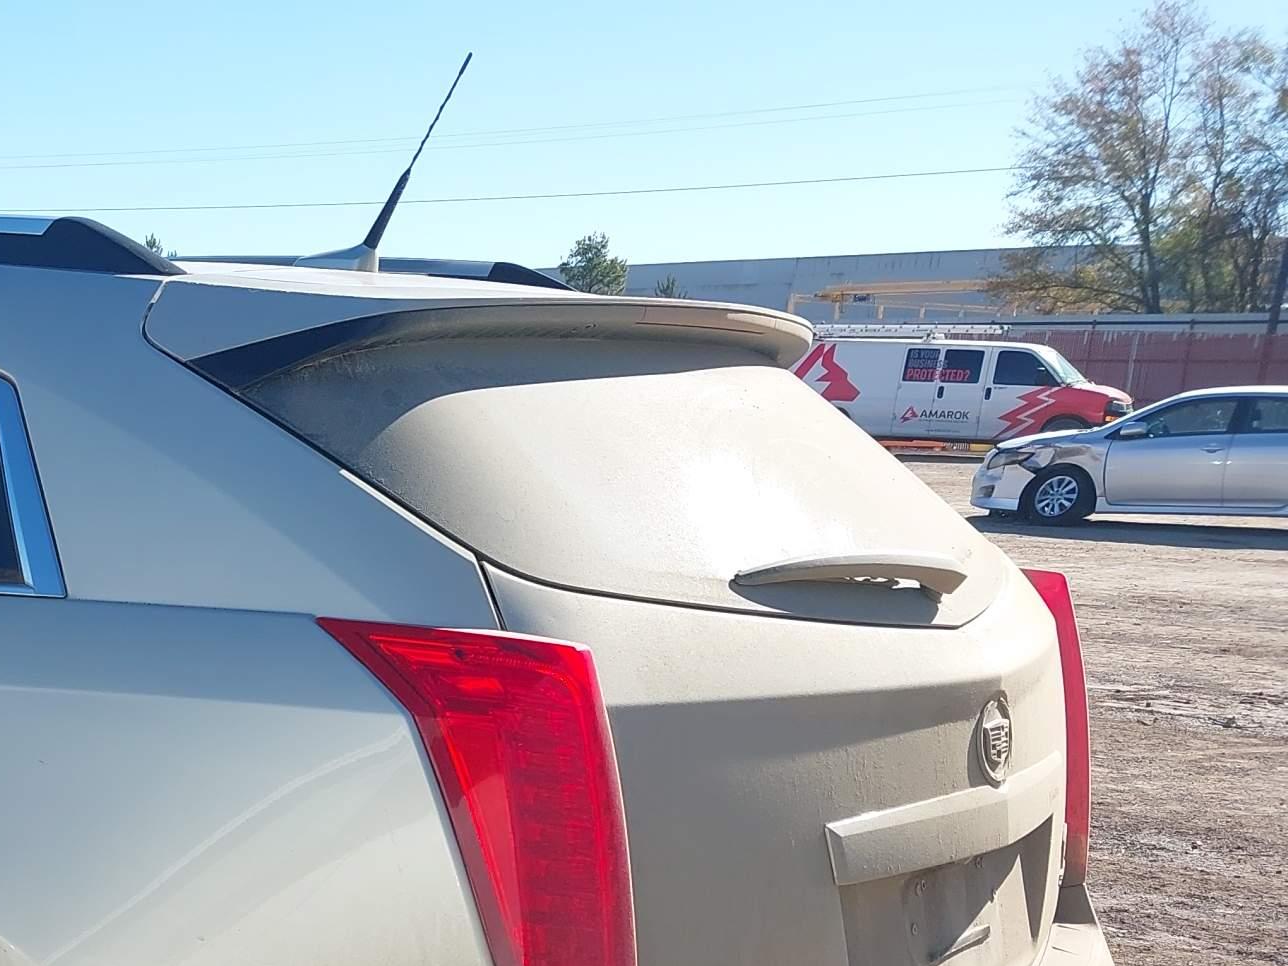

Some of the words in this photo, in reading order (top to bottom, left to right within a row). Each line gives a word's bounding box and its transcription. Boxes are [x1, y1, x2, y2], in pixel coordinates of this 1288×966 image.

[910, 350, 919, 359] IS
[907, 359, 950, 369] BUSINESS
[906, 368, 971, 382] PROTECTED?
[919, 409, 970, 420] AMAROK
